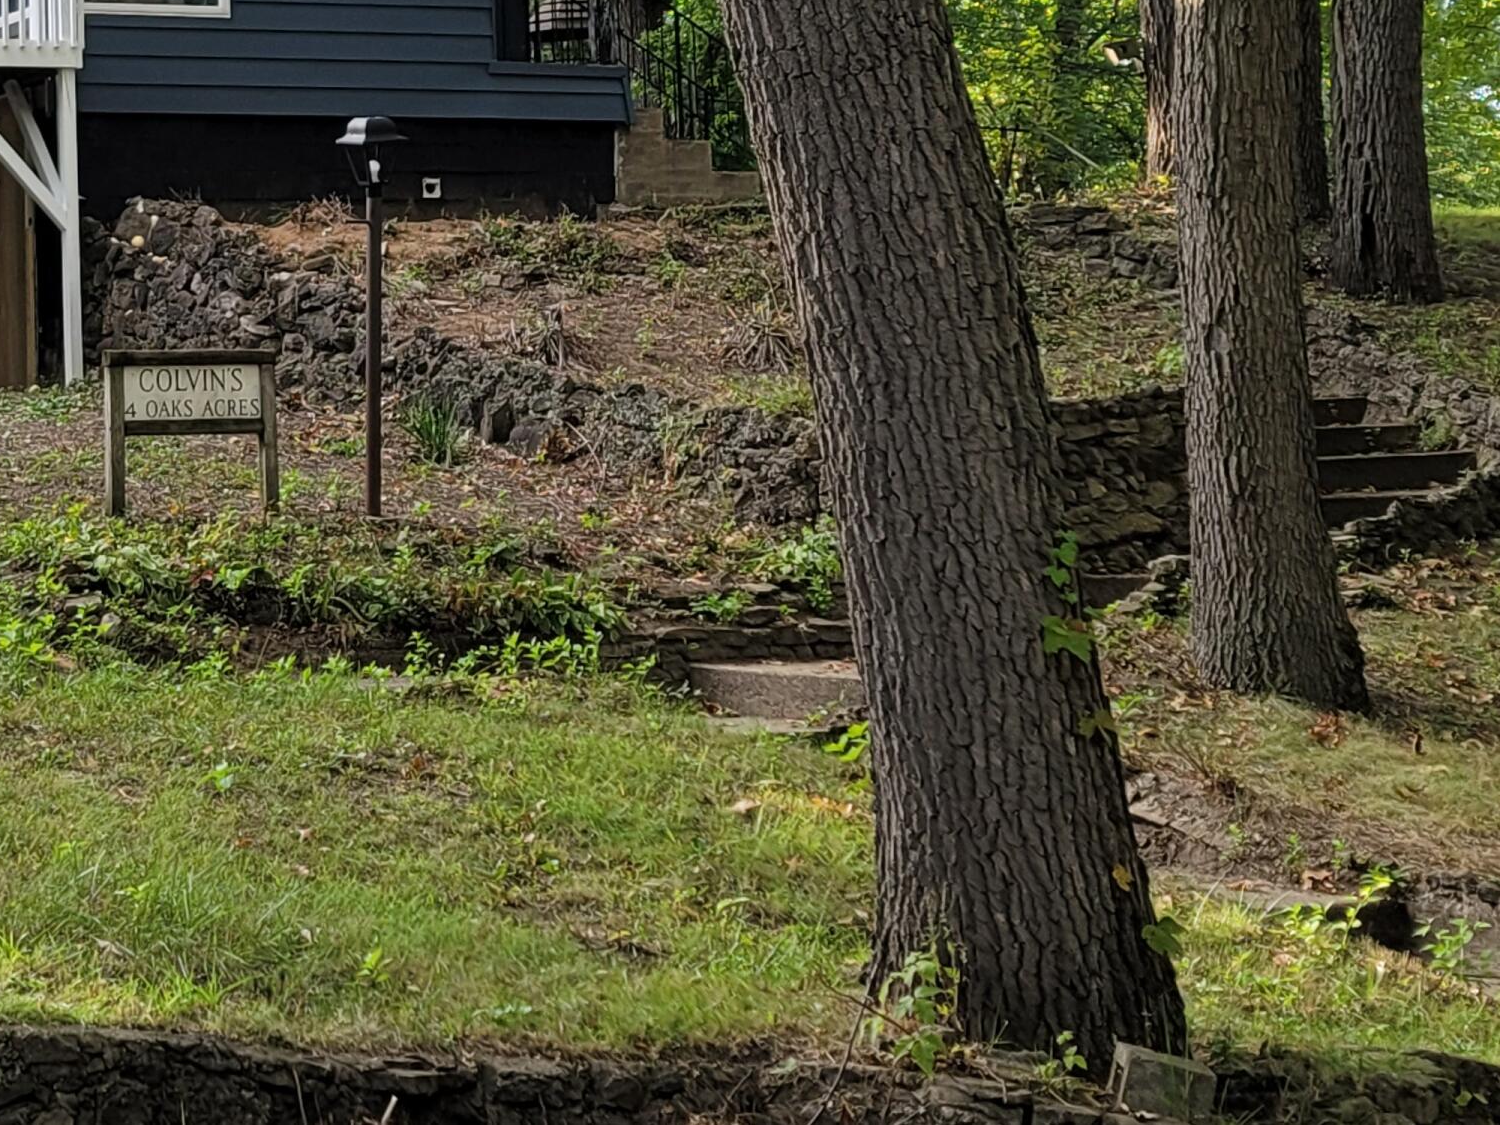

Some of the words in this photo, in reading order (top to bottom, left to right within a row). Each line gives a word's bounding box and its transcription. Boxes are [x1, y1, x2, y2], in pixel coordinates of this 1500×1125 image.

[139, 368, 243, 392] COLVIN'S
[124, 403, 137, 418] 4
[146, 399, 193, 418] OAKS
[202, 398, 260, 417] ACRES
